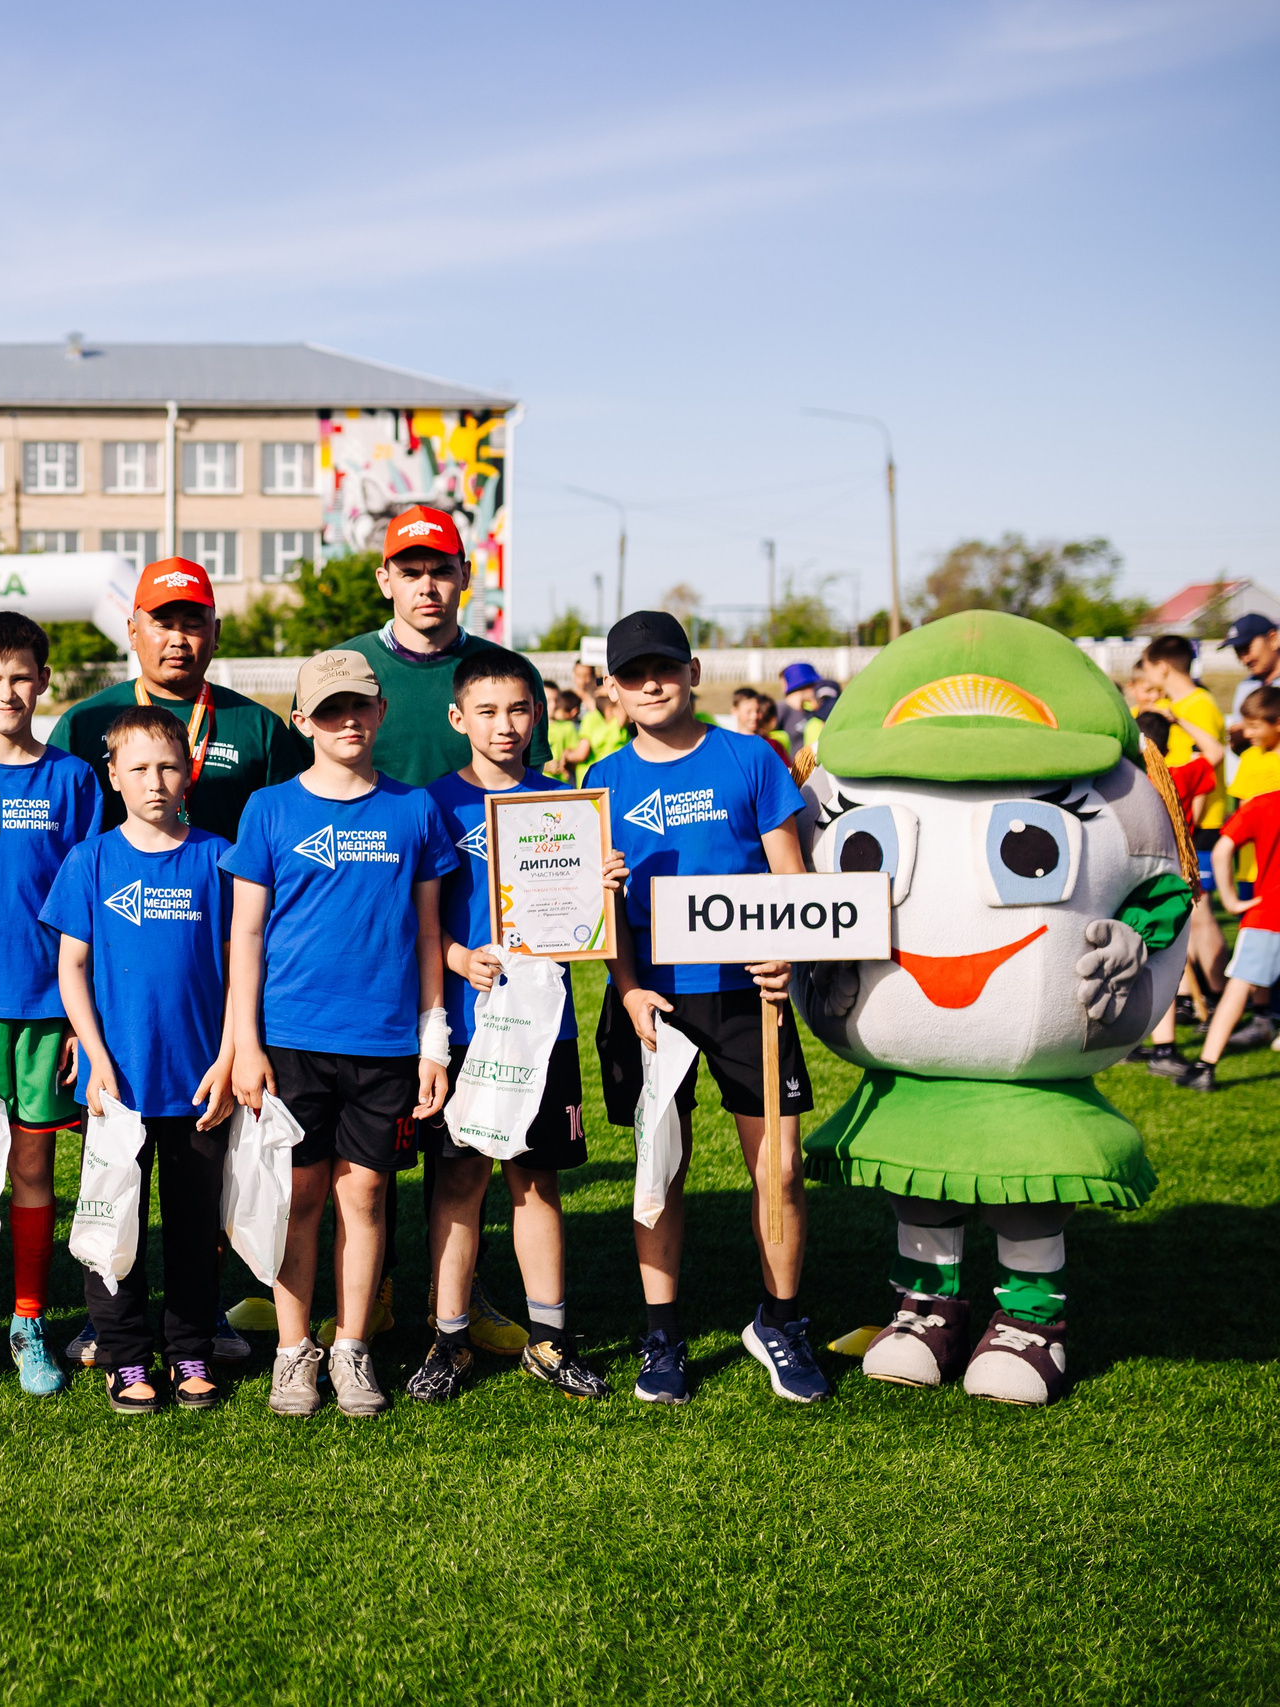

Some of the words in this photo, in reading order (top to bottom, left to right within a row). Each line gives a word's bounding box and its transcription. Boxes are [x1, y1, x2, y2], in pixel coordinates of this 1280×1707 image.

[2, 798, 50, 809] РУССКАЯ
[663, 788, 714, 806] РУССКАЯ
[665, 799, 713, 816] МЕДНАЯ
[2, 809, 49, 820] МЕДНАЯ
[666, 809, 729, 827] КОМПАНИЯ
[2, 819, 60, 832] КОМПАНИЯ
[336, 830, 387, 841] РУССКАЯ
[337, 840, 386, 851] МЕДНАЯ
[534, 841, 561, 853] 2025
[337, 851, 400, 864] КОМПАНИЯ
[519, 857, 581, 872] ДИПЛОМ
[530, 870, 571, 878] УЧАСТНИКА
[144, 887, 193, 899] РУССКАЯ
[143, 897, 191, 910] МЕДНАЯ
[143, 908, 203, 921] КОМПАНИЯ
[688, 893, 859, 939] Юниор
[395, 1115, 415, 1151] 19
